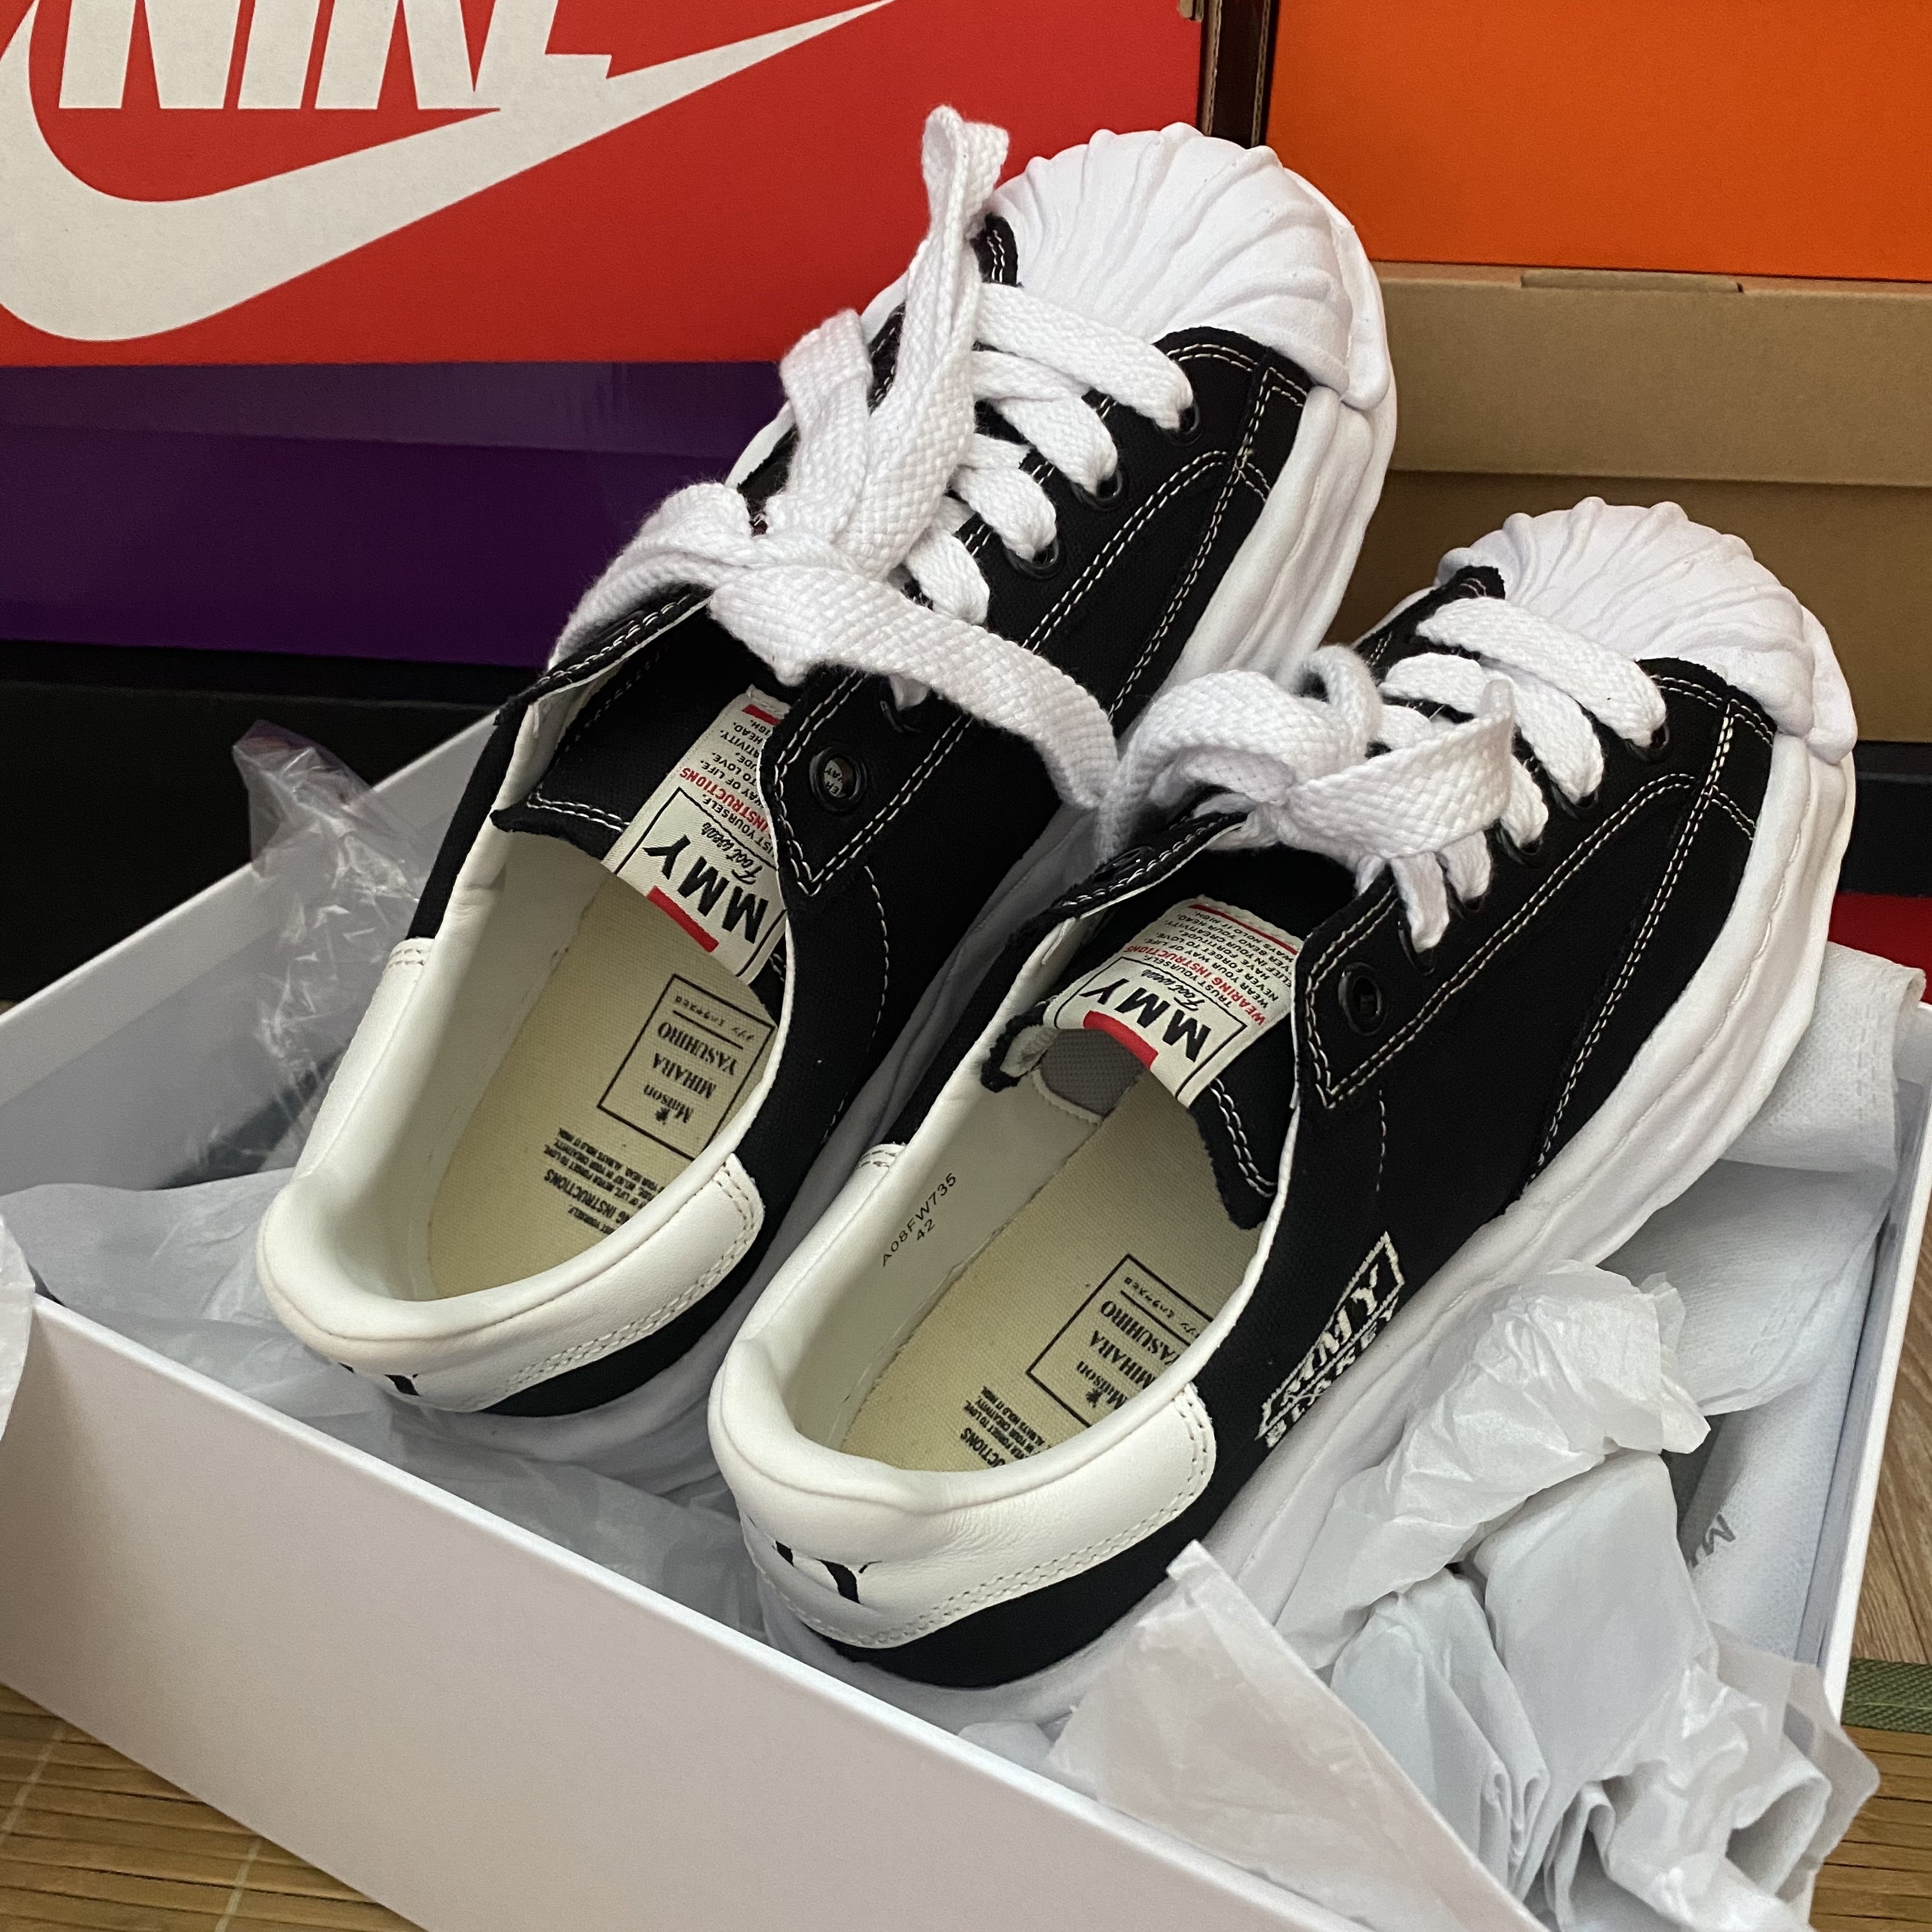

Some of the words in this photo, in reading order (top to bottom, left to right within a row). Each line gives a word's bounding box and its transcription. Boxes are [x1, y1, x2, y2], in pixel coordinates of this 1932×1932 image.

[750, 720, 770, 735] IGH.
[720, 730, 760, 758] ATIVITY.
[700, 760, 724, 779] LIFE.
[712, 753, 741, 774] LOVE.
[725, 778, 740, 789] OF
[742, 773, 756, 786] TO
[679, 766, 768, 832] INSTRUCTIONS
[702, 794, 752, 838] YOURSELF.
[642, 834, 768, 943] MMY
[1208, 925, 1234, 939] YOUR
[1184, 949, 1210, 963] WAY
[1185, 940, 1200, 949] TO
[1225, 940, 1254, 959] YOUR
[1262, 942, 1293, 962] WAYS
[1123, 944, 1211, 978] INSTRUCTIONS
[1201, 946, 1243, 973] FORGET
[1240, 959, 1269, 980] HAVE
[1254, 956, 1267, 966] IN
[1268, 955, 1291, 974] VER
[1211, 962, 1239, 983] YOUR
[1264, 965, 1292, 987] ELIEF
[1197, 979, 1232, 1008] TRUST
[1239, 982, 1268, 1008] WEAR
[1243, 972, 1278, 1001] NEVER
[1211, 976, 1264, 1025] WEARING
[1078, 977, 1211, 1062] MMY
[657, 1022, 737, 1075] YASUHIRO
[652, 1052, 716, 1099] MIHARA
[543, 1167, 617, 1218] INSTRUCTIONS
[883, 1173, 956, 1267] A08FW735
[917, 1218, 935, 1240] 42
[1089, 1330, 1156, 1390] MIHARA
